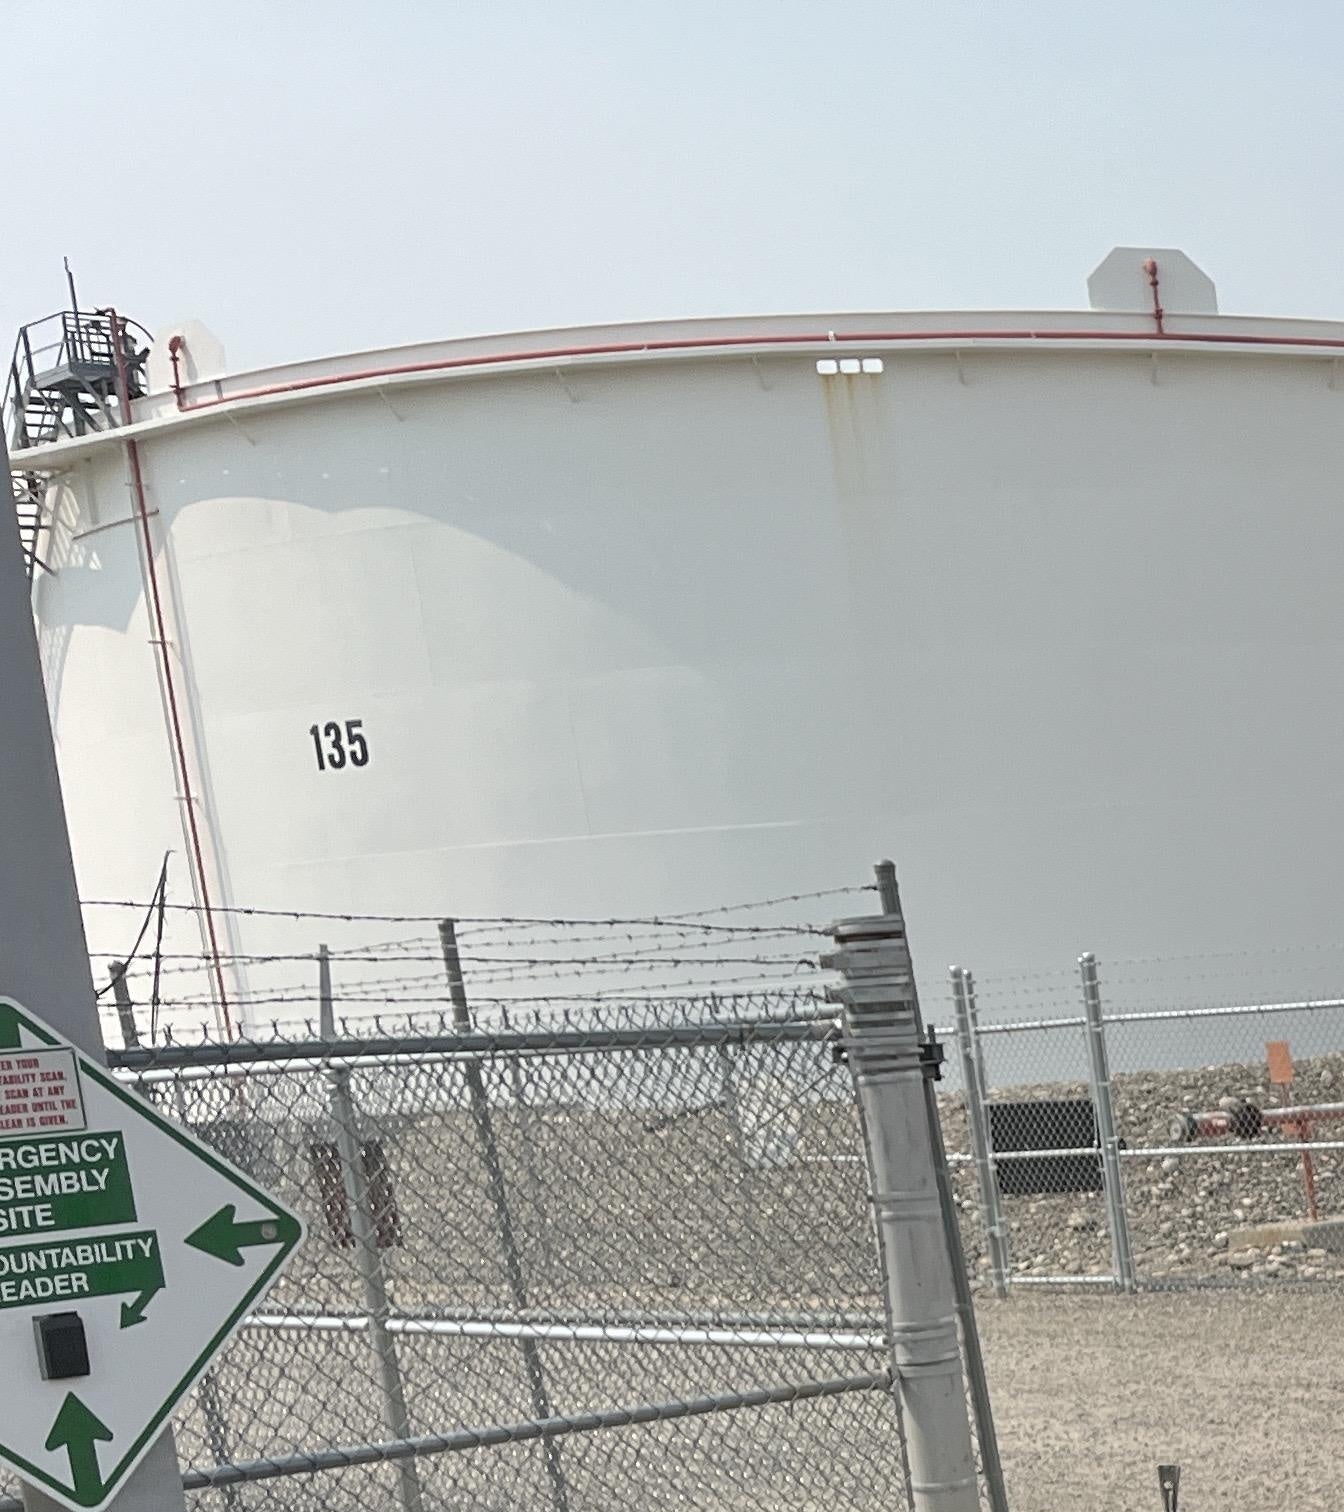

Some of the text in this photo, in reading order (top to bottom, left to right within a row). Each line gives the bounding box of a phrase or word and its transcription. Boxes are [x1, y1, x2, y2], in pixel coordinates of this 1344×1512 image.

[309, 719, 369, 771] 135
[5, 1086, 65, 1100] SCAN AT ANY
[32, 1101, 58, 1112] UNTIL
[60, 1099, 77, 1109] THE
[26, 1117, 36, 1127] IS
[0, 1136, 119, 1170] RGENCY
[0, 1167, 110, 1201] SEMBLY
[0, 1203, 56, 1233] SITE
[0, 1272, 90, 1302] EADER
